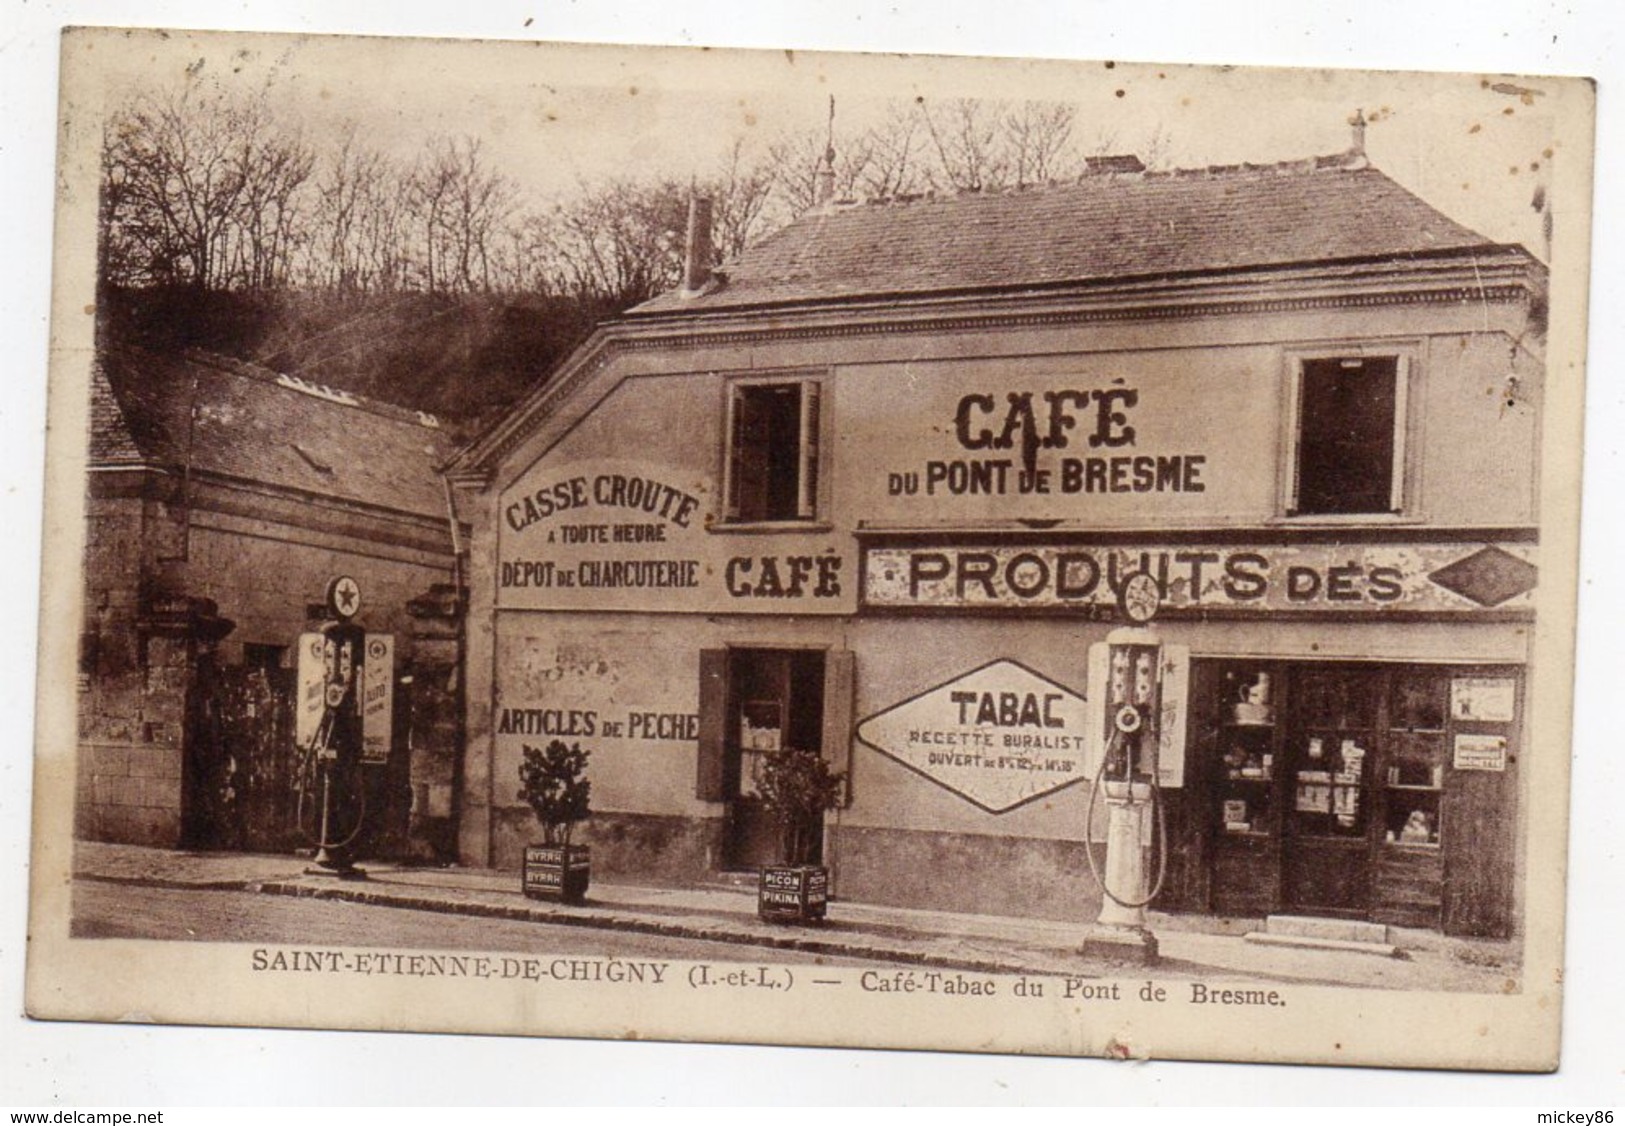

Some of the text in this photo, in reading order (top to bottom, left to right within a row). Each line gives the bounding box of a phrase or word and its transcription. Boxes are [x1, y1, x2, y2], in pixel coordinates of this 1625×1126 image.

[954, 378, 1138, 450] CAFÉ
[889, 455, 1206, 495] DU PONT DE BRESME
[506, 474, 700, 531] CASSE CROUTE
[560, 525, 608, 543] TOUTE
[613, 523, 666, 543] HEURE
[557, 570, 575, 586] DE
[578, 560, 699, 587] CHARCUTERIE
[725, 547, 842, 598] CAFÉ
[910, 553, 1269, 600] PRODUITS
[498, 709, 700, 740] ARTICLES DE PECHE
[951, 691, 1064, 728] TABAC
[910, 730, 1086, 750] RECETTE BURALIST
[928, 752, 982, 767] OUVERT
[765, 874, 800, 886] PICON
[762, 891, 800, 904] PIKINA
